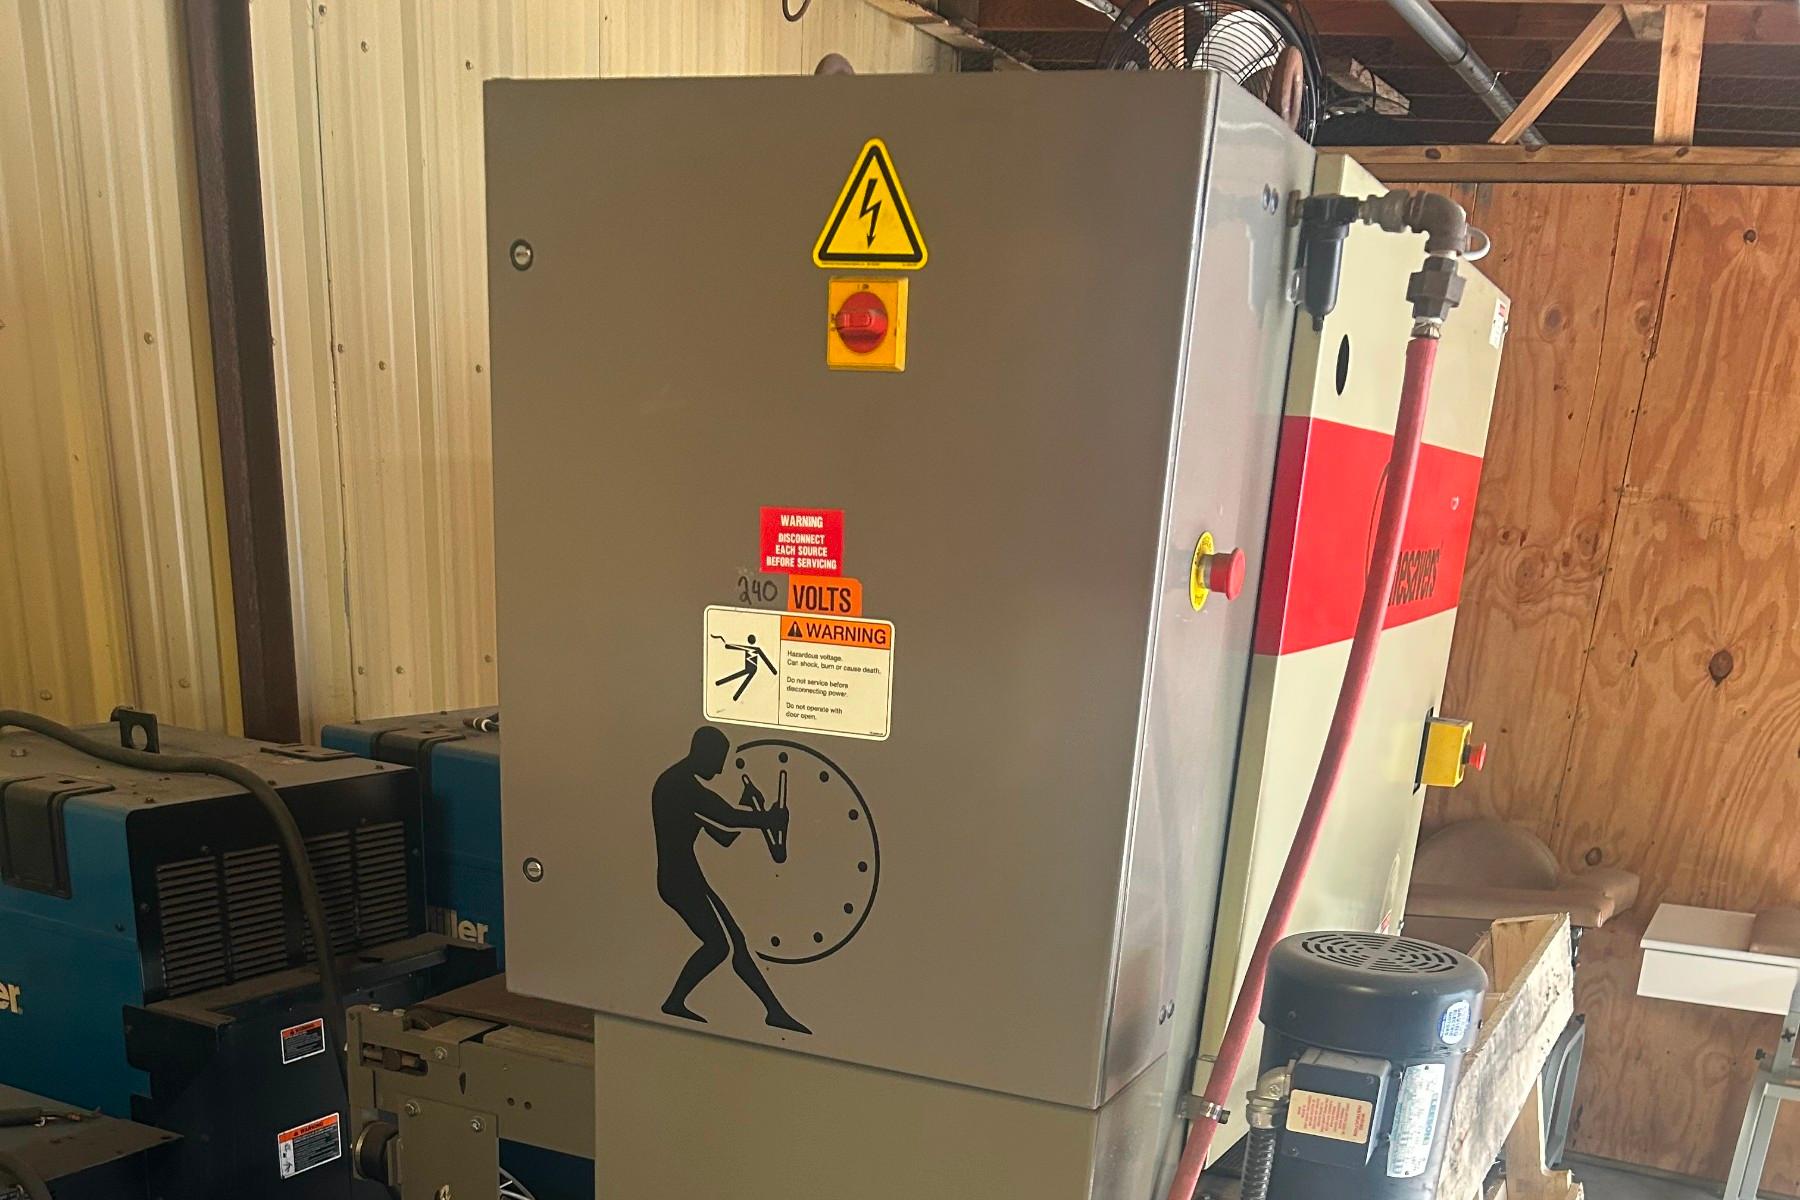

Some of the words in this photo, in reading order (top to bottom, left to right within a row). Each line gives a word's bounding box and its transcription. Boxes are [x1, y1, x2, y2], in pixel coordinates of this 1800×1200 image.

[781, 514, 824, 529] WARNING
[778, 532, 825, 545] DISCONNECT
[775, 545, 796, 556] EACH
[797, 546, 828, 557] SOURCE
[766, 556, 795, 568] BEFORE
[797, 557, 837, 570] SERVICING
[738, 575, 778, 606] 240
[793, 584, 851, 613] VOLTS
[806, 622, 886, 645] WARNING
[787, 650, 818, 660] Hazardous
[820, 654, 843, 663] voltage.
[800, 661, 819, 669] shock,
[821, 662, 834, 670] burn
[862, 666, 881, 674] death.
[796, 677, 806, 685] not
[807, 679, 828, 687] service
[830, 681, 849, 689] before
[787, 686, 827, 697] disconnecting
[807, 705, 829, 713] operate
[830, 707, 842, 715] with
